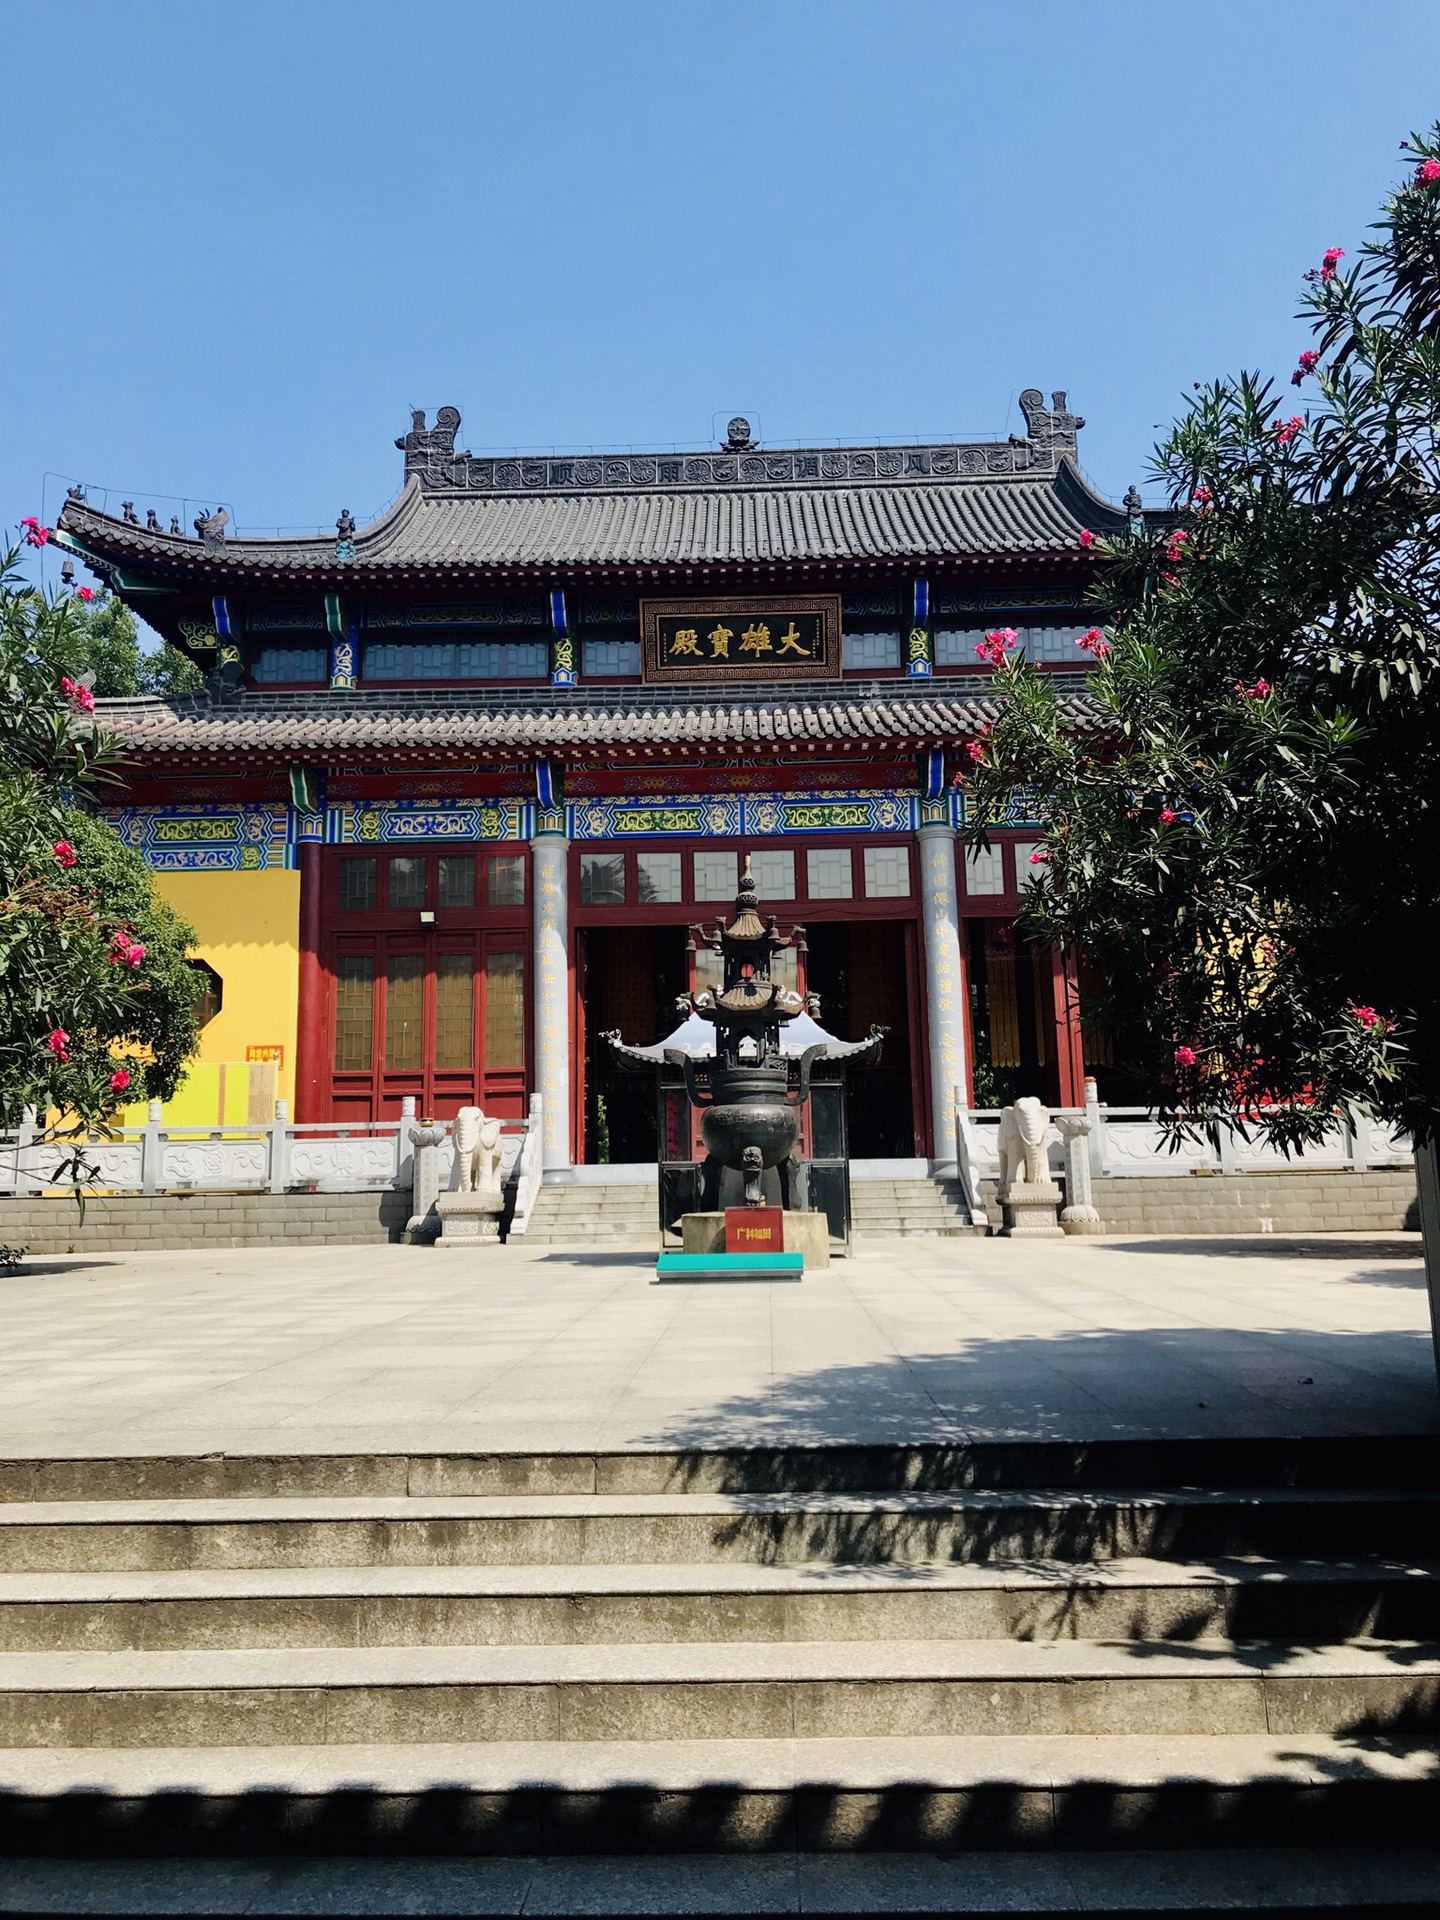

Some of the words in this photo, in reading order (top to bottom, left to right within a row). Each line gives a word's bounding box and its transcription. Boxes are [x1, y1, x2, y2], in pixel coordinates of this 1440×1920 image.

[550, 462, 576, 486] 顺
[658, 460, 684, 483] 雨
[794, 453, 820, 478] 调
[906, 452, 930, 475] 风
[668, 621, 812, 659] 大雄寶殿
